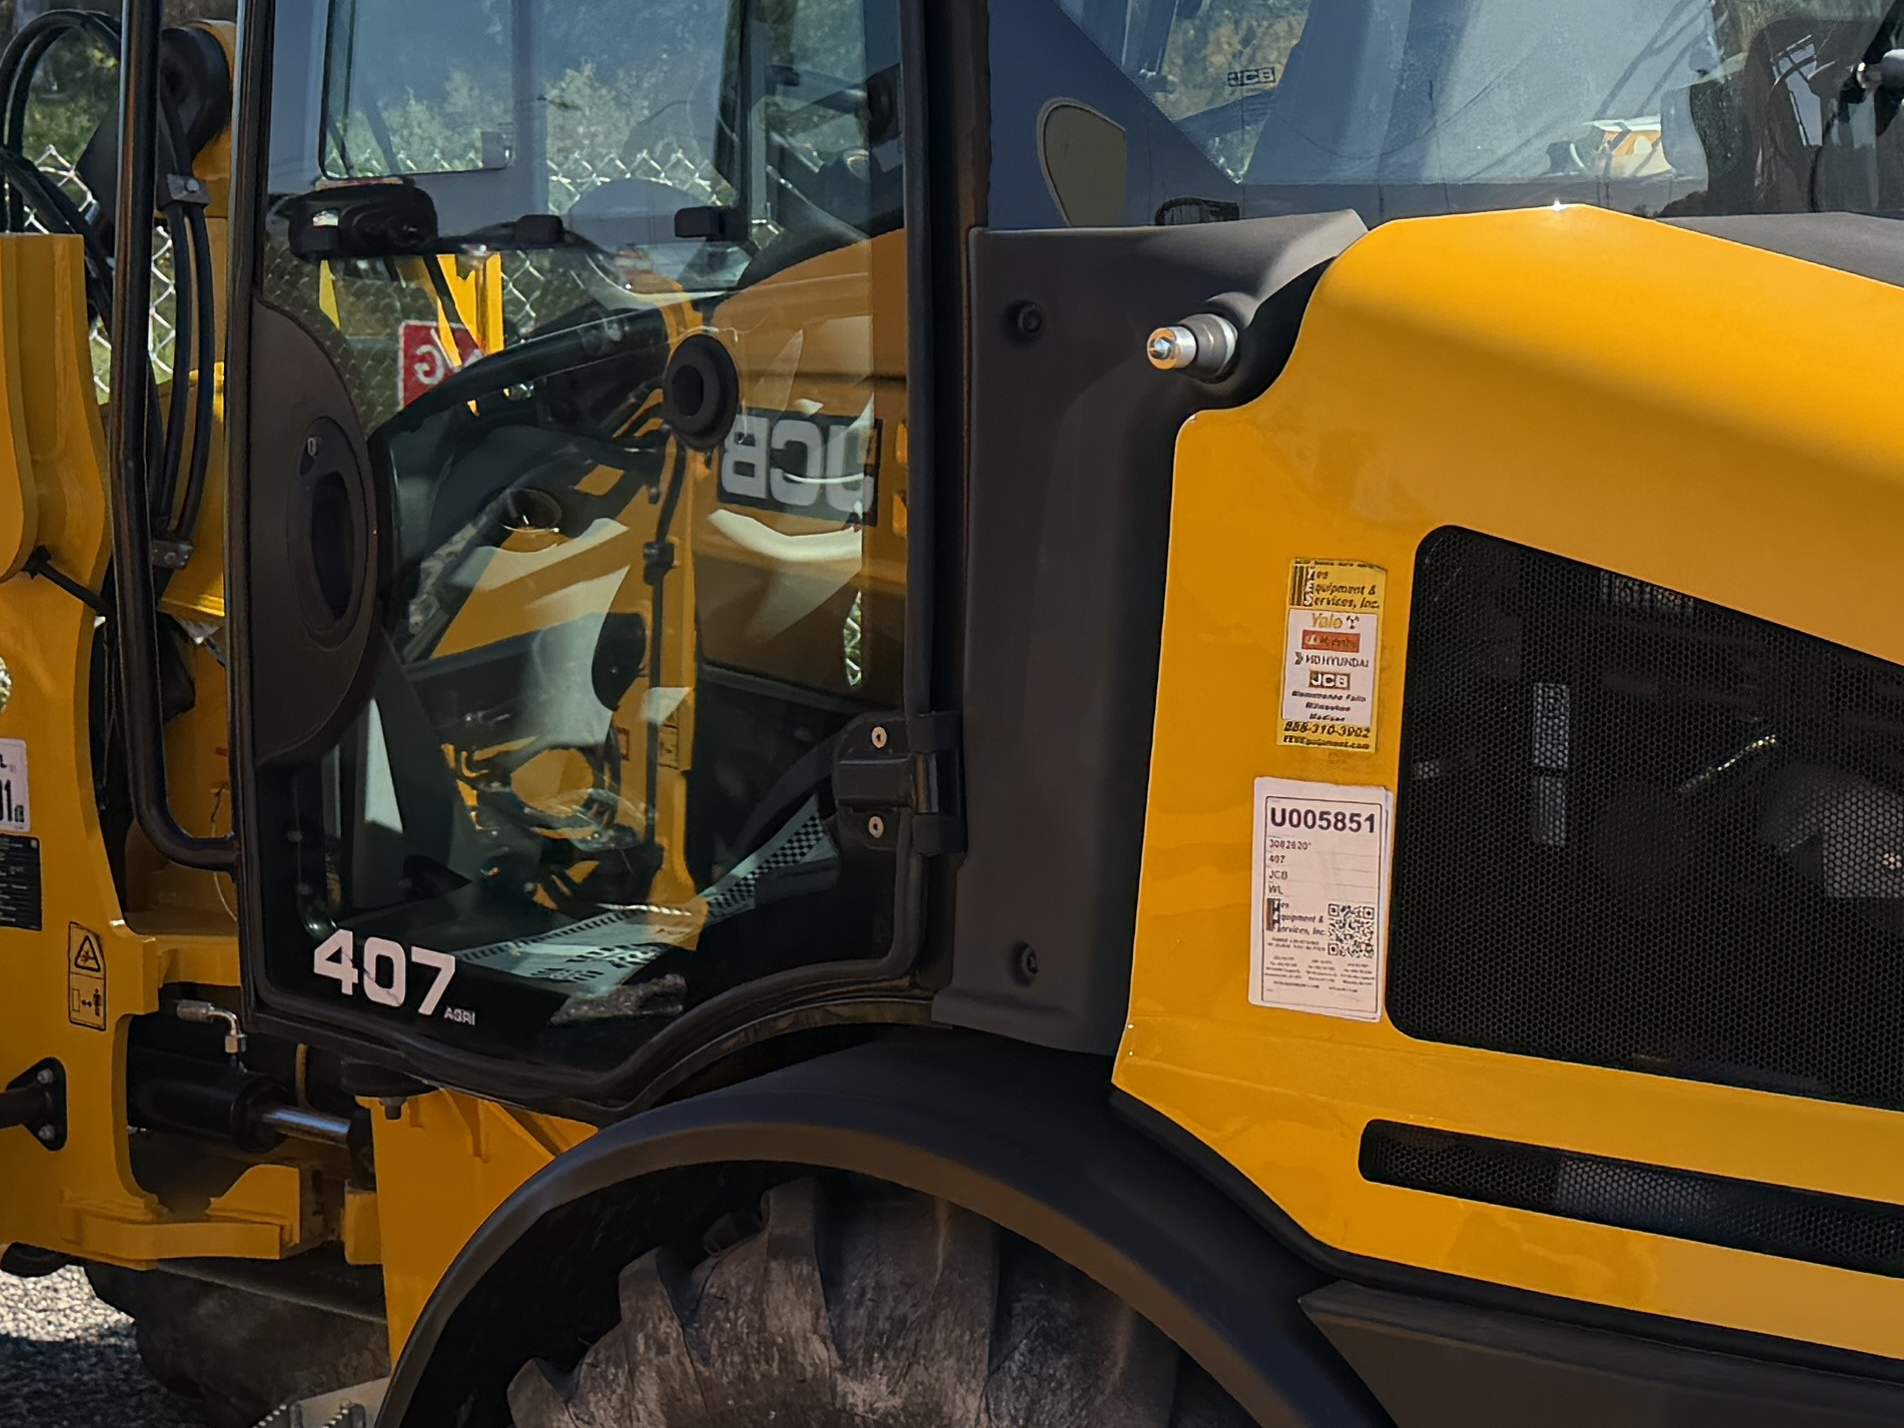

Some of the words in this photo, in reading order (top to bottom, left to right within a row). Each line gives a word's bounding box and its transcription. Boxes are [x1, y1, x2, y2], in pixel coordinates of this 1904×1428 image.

[1322, 656, 1369, 668] HYUNDAI
[1311, 673, 1348, 688] JCB
[1270, 807, 1376, 833] U005851
[314, 929, 456, 1016] 407
